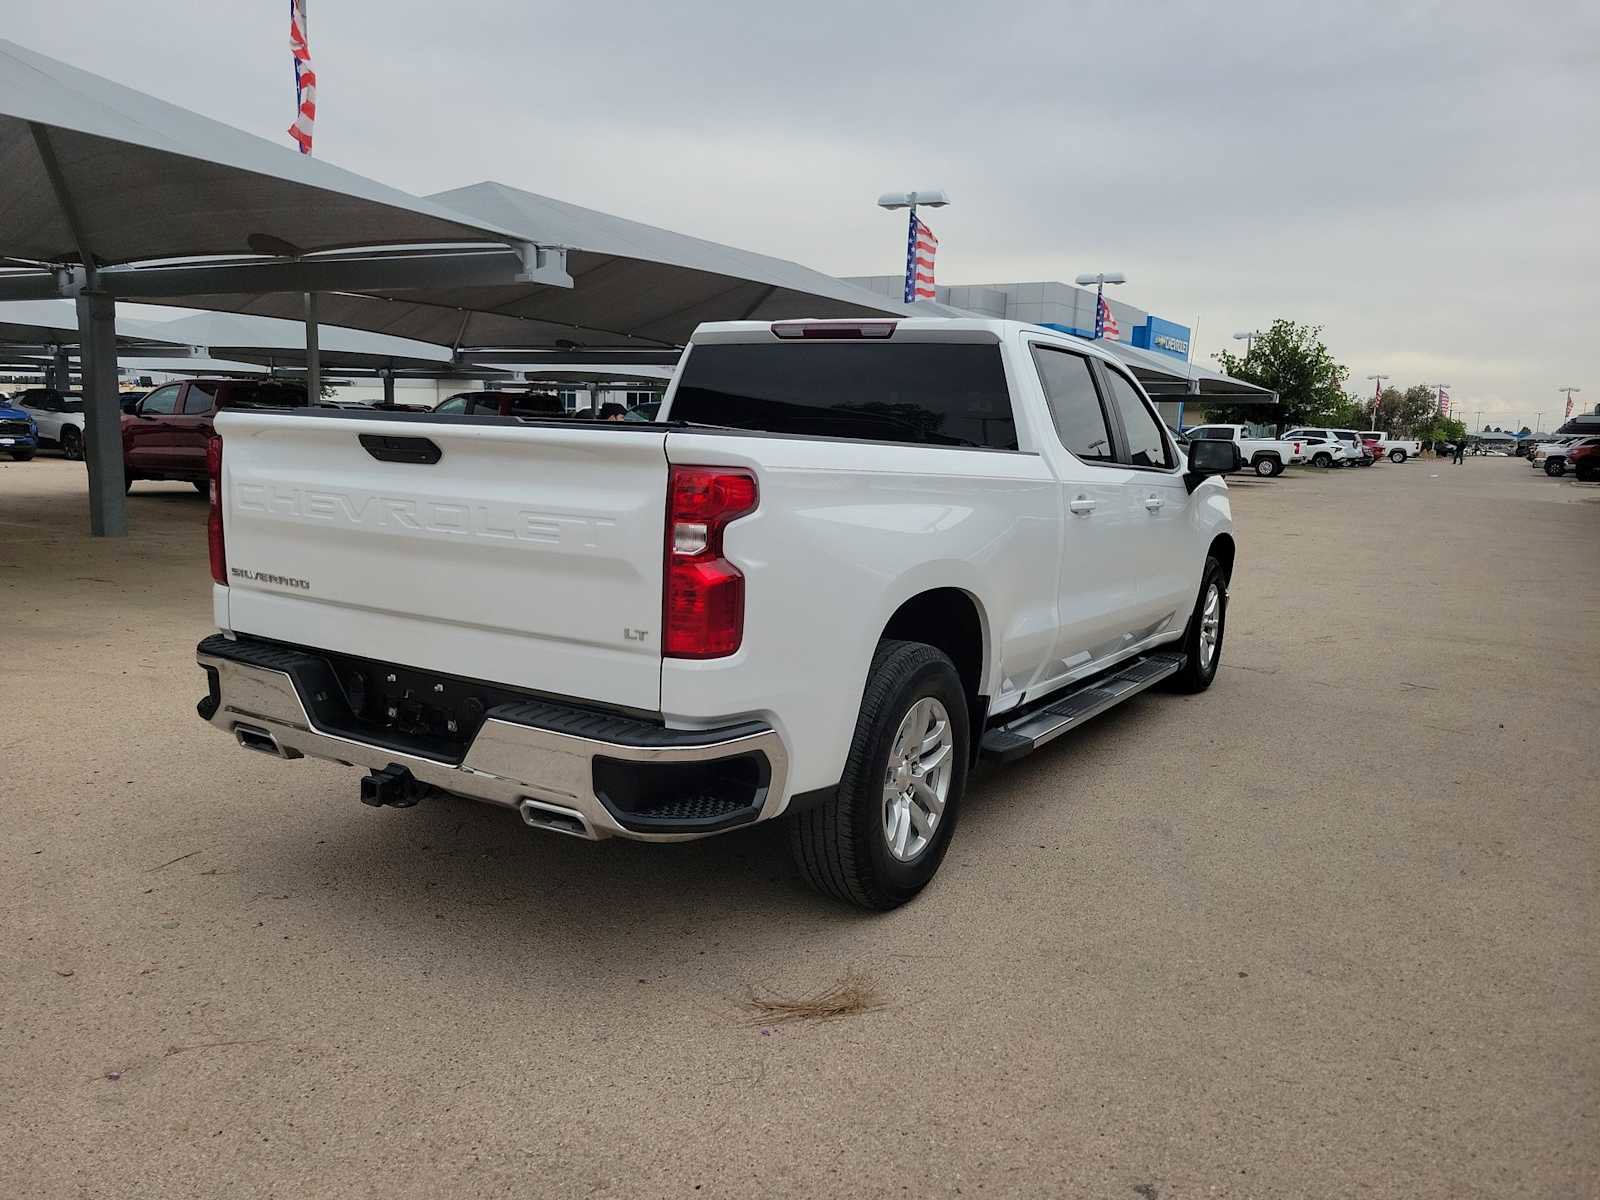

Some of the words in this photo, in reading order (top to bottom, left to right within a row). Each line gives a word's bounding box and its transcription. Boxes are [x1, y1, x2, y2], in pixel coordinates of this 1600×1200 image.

[235, 482, 617, 549] CHEVROLET
[231, 567, 310, 590] SILVERADO
[623, 627, 648, 642] LT
